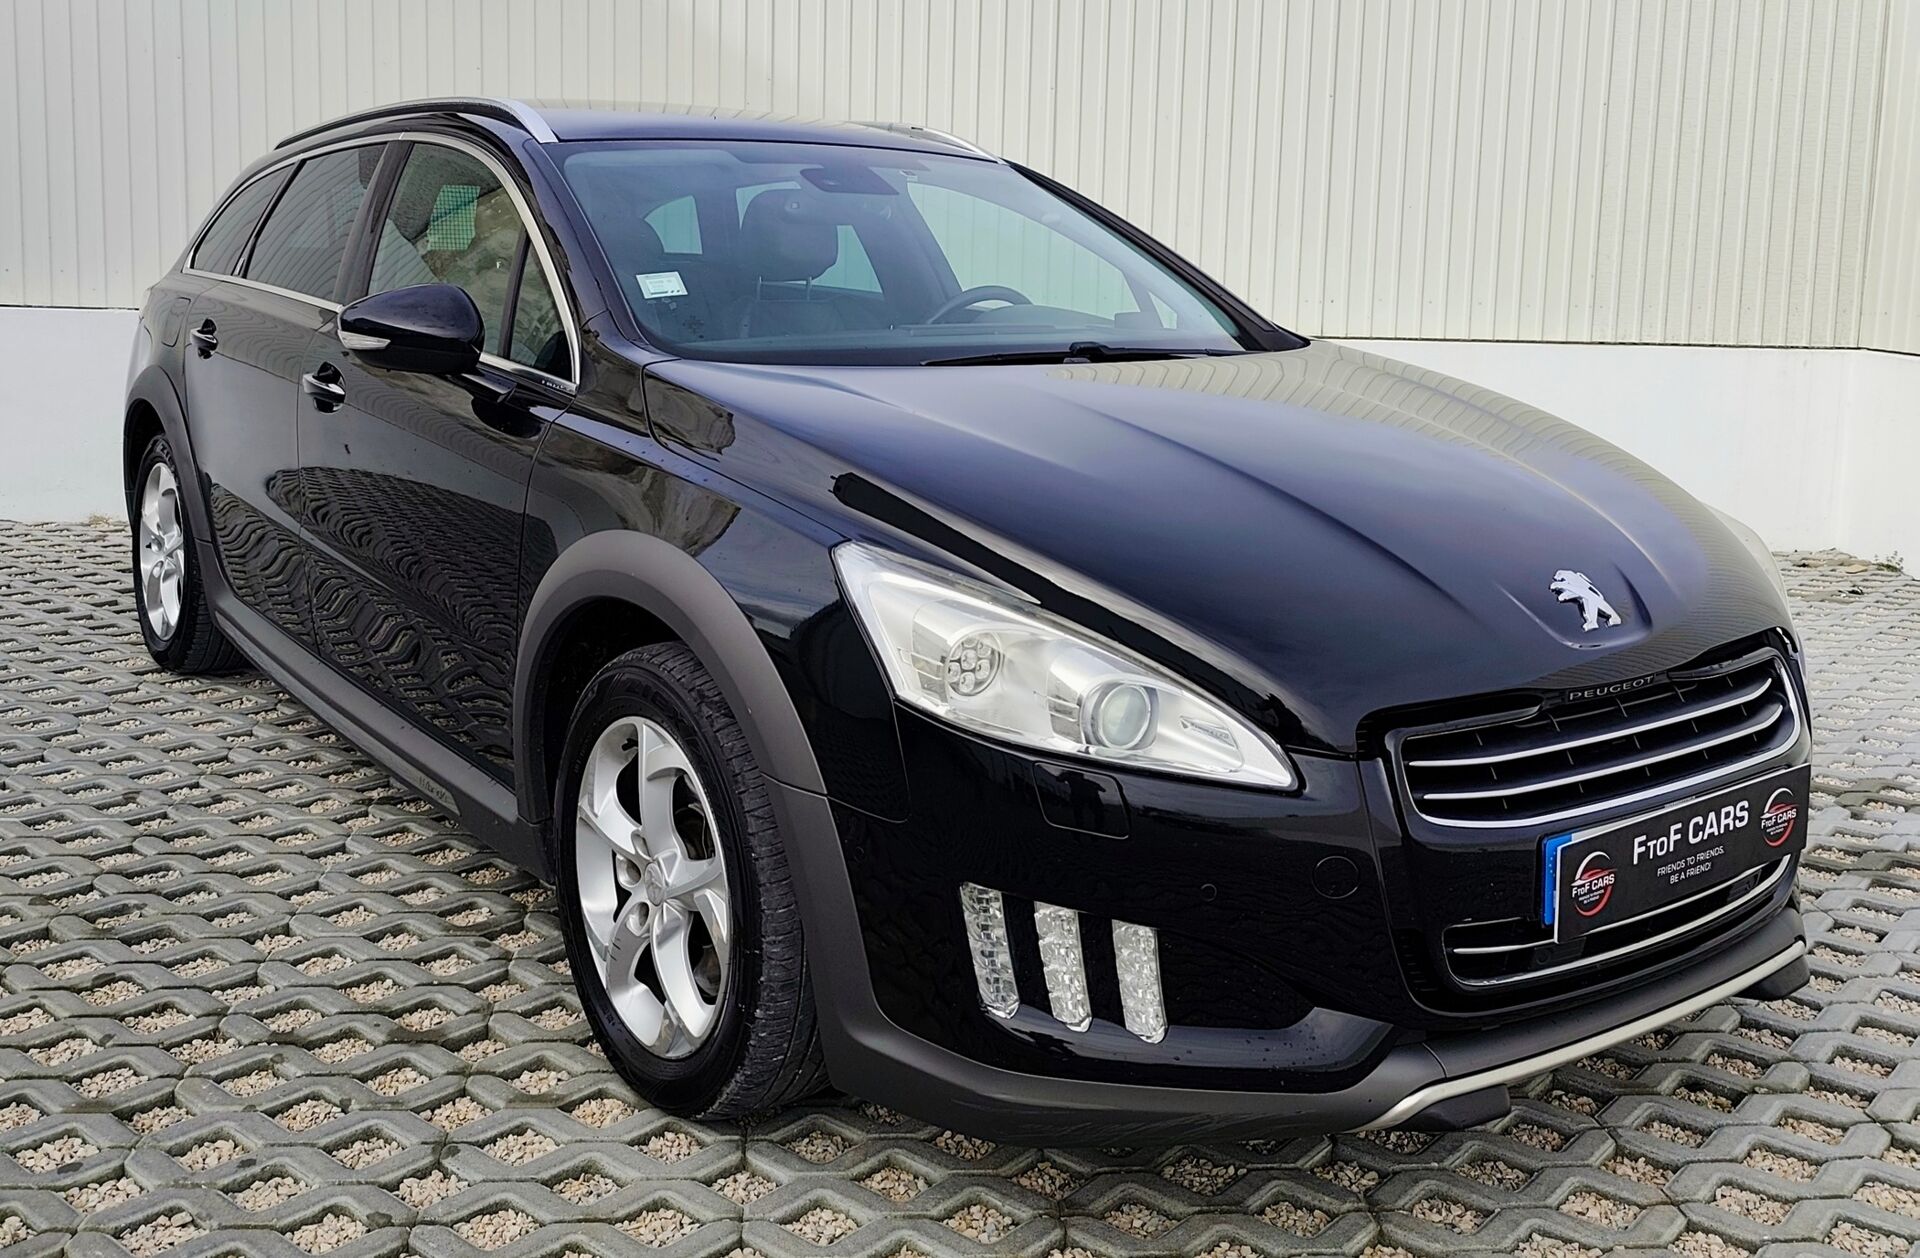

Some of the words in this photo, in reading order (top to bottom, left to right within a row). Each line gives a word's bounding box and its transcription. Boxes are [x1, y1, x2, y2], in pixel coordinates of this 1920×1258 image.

[1569, 676, 1654, 700] PEUGEOT
[1688, 800, 1749, 845] CARS
[1777, 808, 1797, 823] CARS
[1657, 859, 1685, 877] FRIENDS
[1686, 856, 1695, 866] TO
[1670, 873, 1679, 884] BE
[1680, 871, 1685, 880] A
[1686, 862, 1711, 878] FRIEND!
[1591, 873, 1615, 891] CARS
